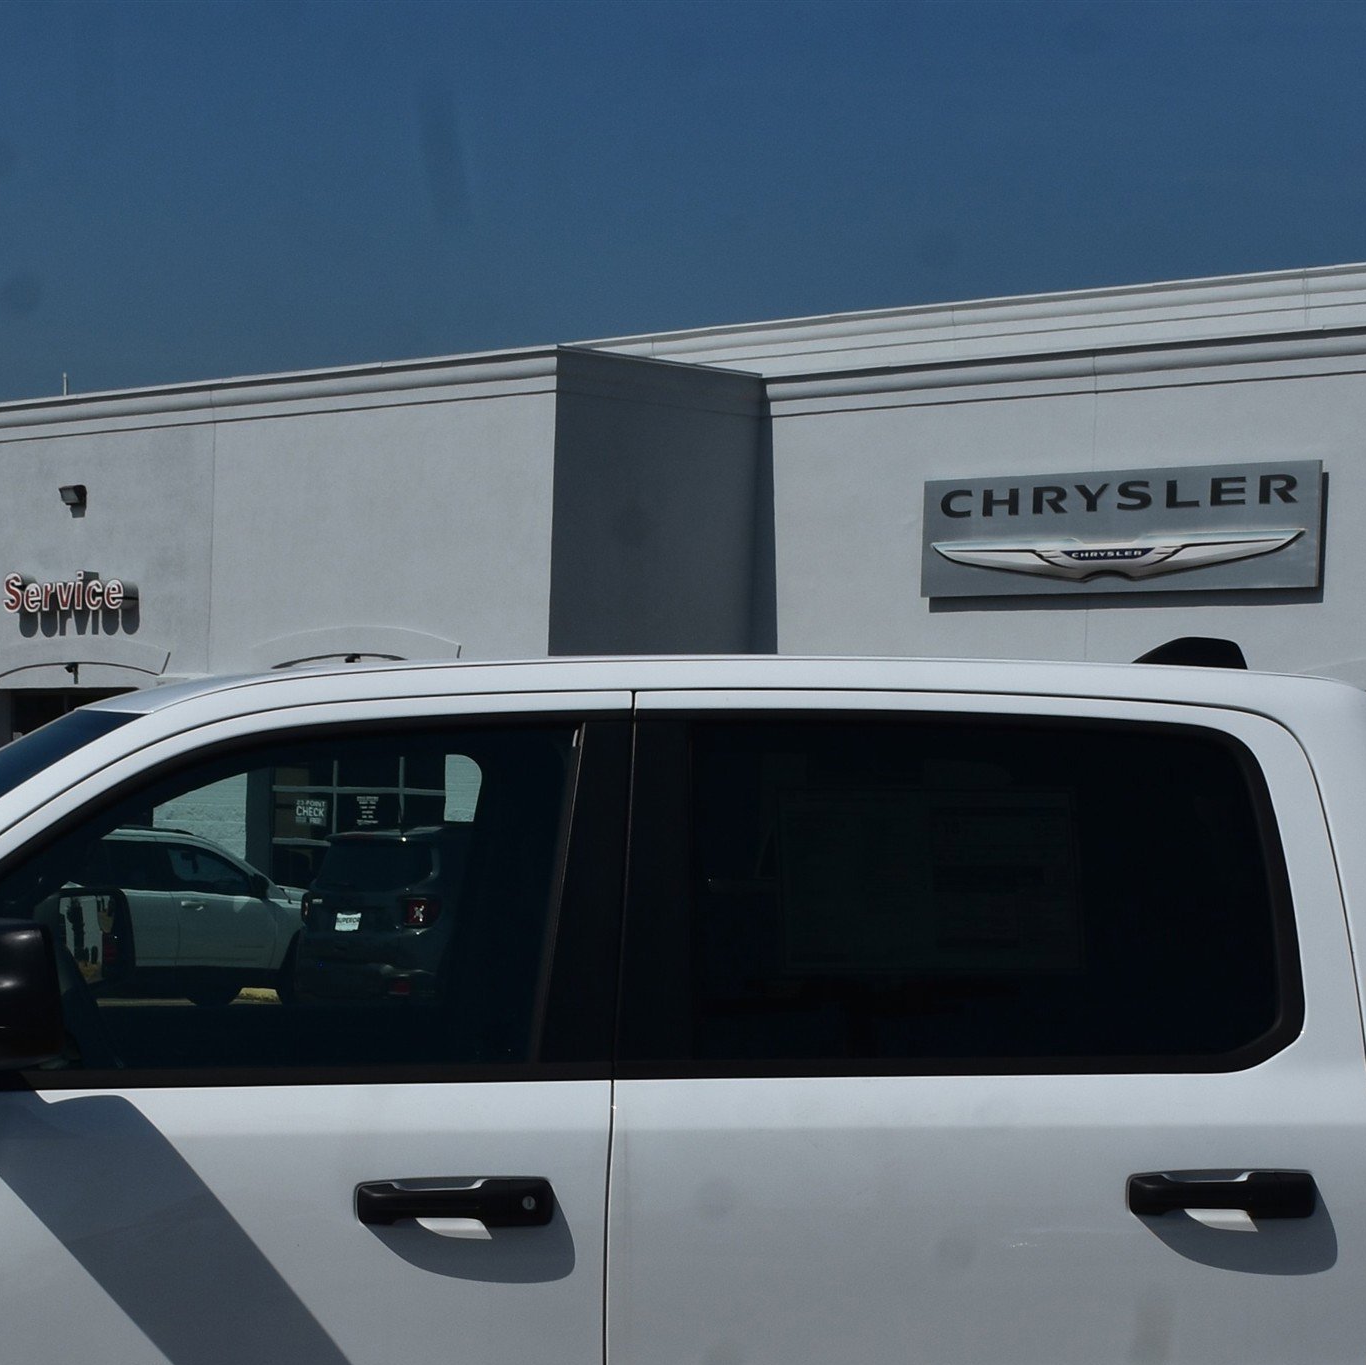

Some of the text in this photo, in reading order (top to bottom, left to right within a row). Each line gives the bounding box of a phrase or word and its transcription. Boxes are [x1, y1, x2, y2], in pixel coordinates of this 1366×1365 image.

[940, 473, 1300, 519] CHRYSLER
[1071, 550, 1143, 558] CHRYSLER
[2, 569, 125, 614] Service
[295, 805, 325, 817] CHECK
